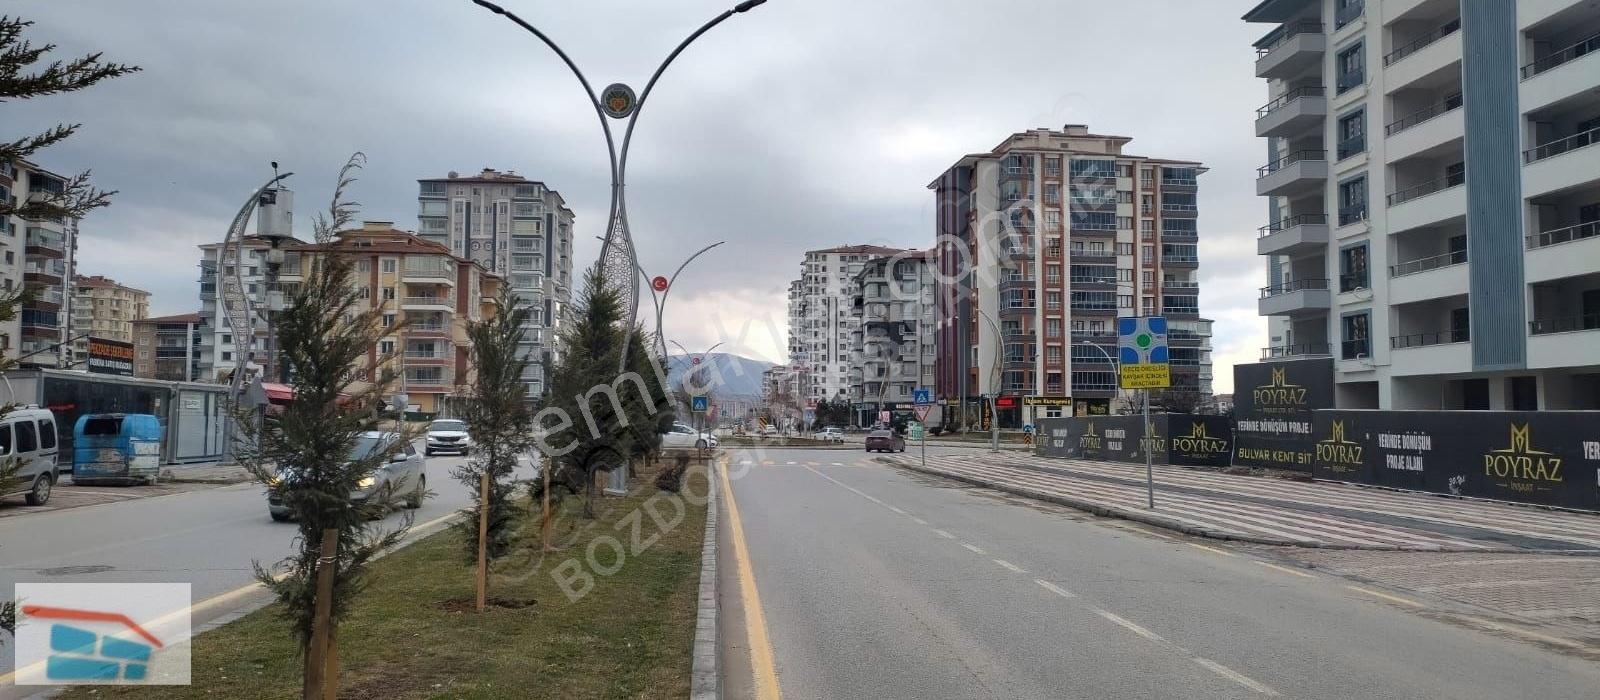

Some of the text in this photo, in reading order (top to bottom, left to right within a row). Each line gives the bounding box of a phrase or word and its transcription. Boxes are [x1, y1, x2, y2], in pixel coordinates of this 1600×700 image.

[1253, 388, 1306, 405] POYRAZ
[1289, 422, 1309, 434] PROJE
[1172, 438, 1229, 453] POYRAZ
[1378, 431, 1431, 453] YERİNDE DÖNÜŞÜM
[1239, 448, 1270, 461] BULVAR
[1272, 450, 1295, 464] KENT
[1316, 444, 1362, 464] POYRAZ
[1386, 454, 1404, 470] PROJE
[1484, 454, 1563, 481] POYRAZ
